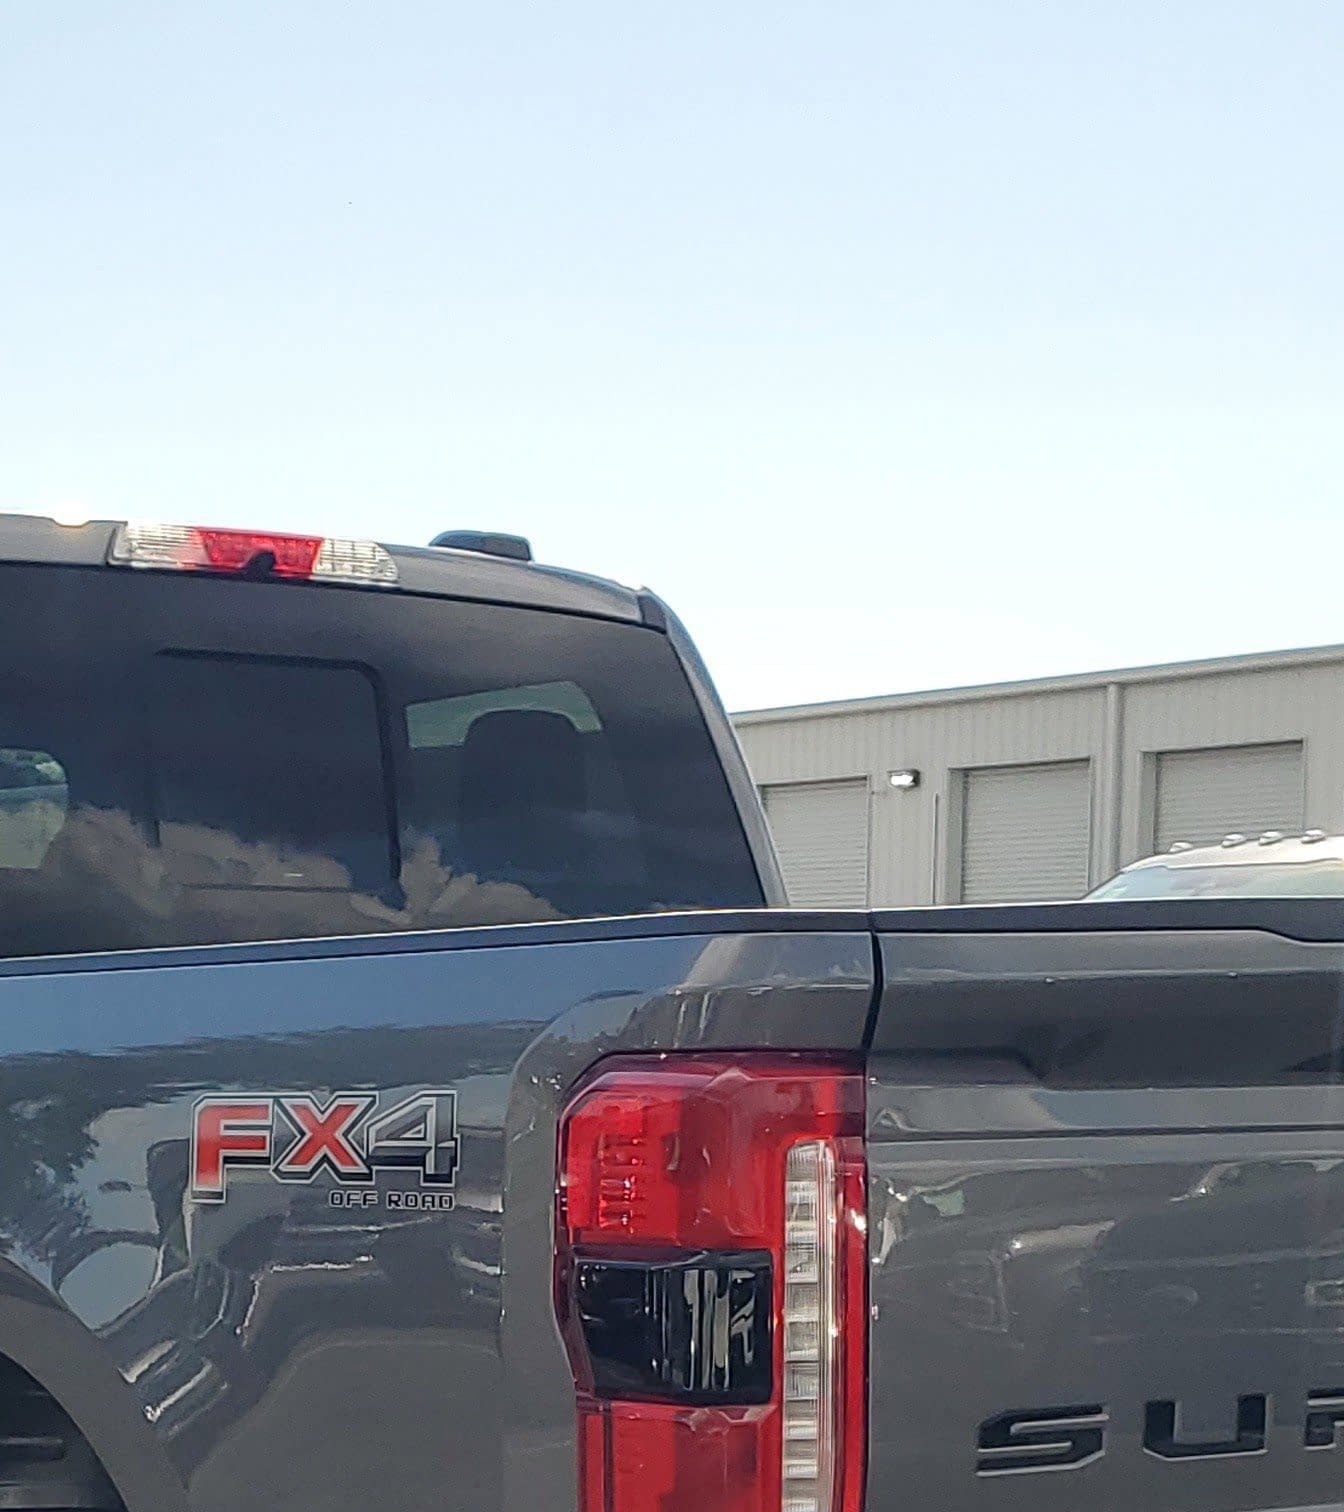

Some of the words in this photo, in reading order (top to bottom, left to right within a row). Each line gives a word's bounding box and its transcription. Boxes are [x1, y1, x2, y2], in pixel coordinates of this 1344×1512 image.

[190, 1089, 461, 1204] FX4
[329, 1189, 379, 1208] OFF
[386, 1191, 455, 1211] ROAD
